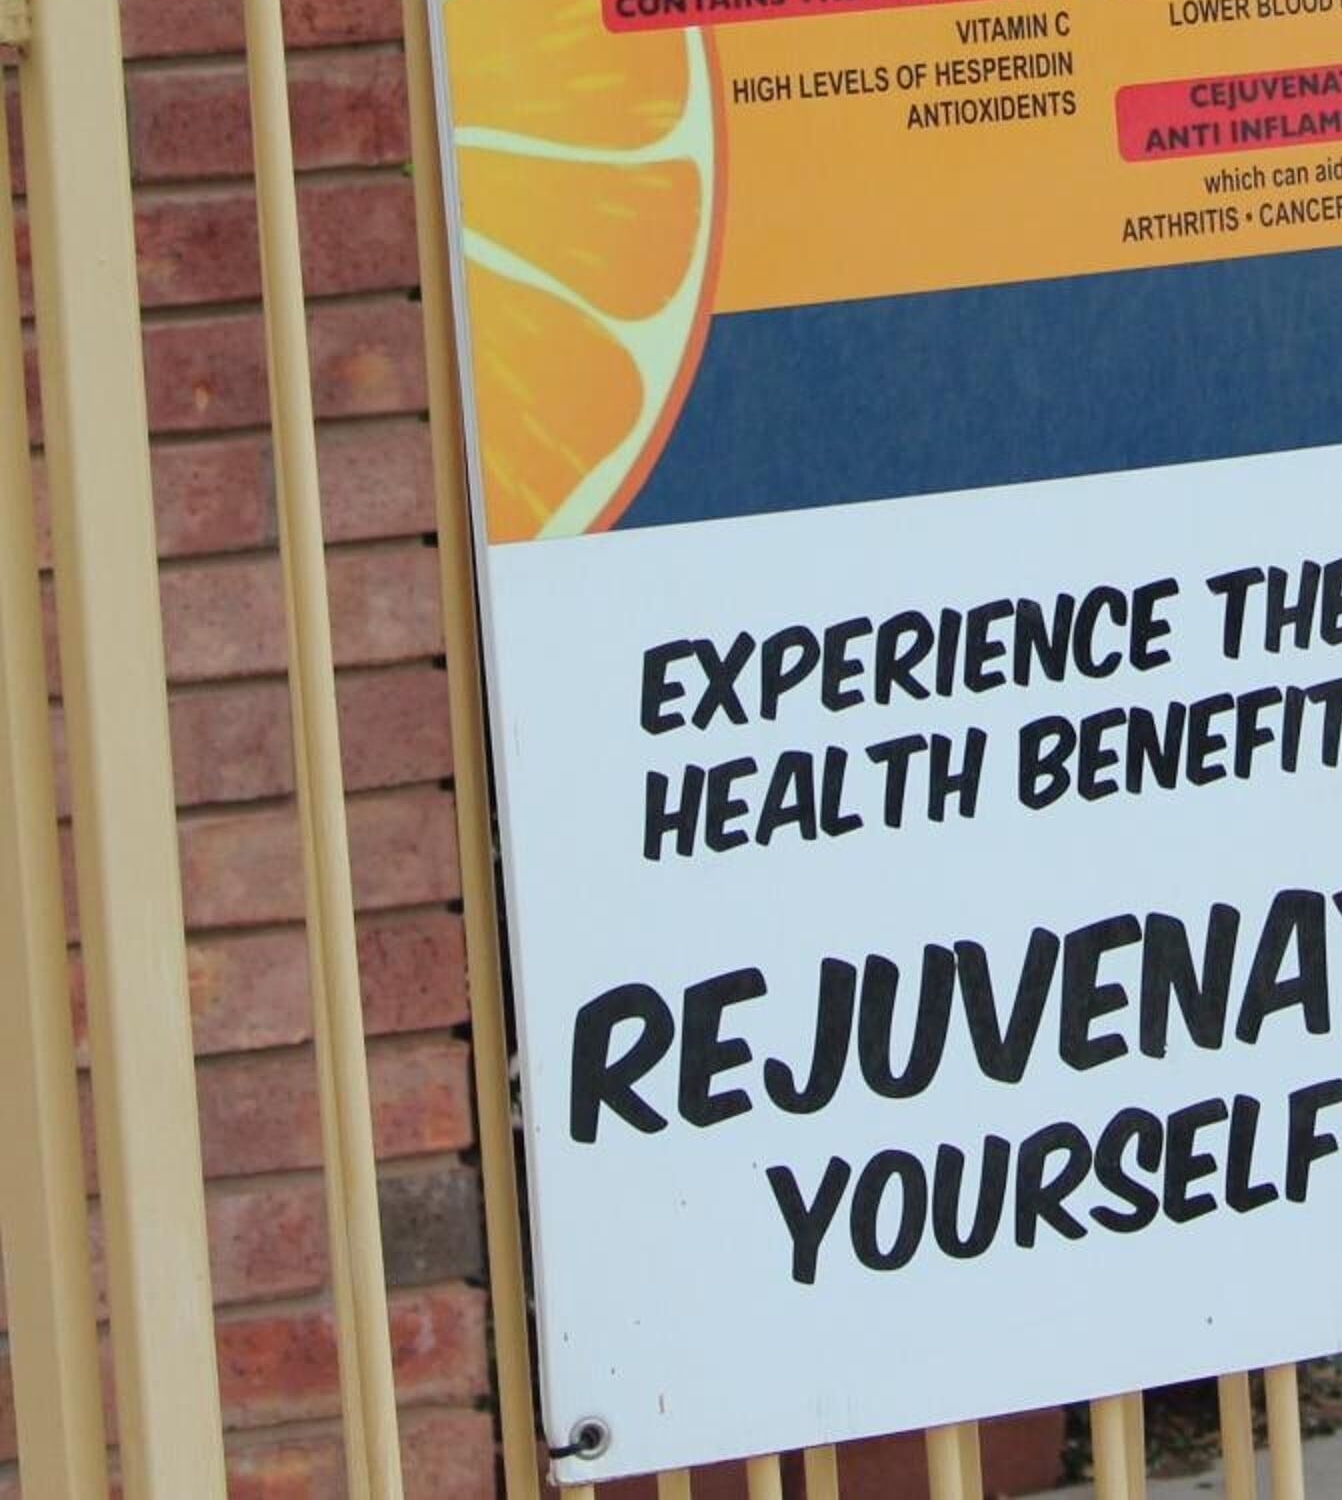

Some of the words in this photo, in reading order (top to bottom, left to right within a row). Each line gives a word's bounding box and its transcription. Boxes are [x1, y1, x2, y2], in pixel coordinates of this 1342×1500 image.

[956, 14, 1048, 44] VITAMIN
[1055, 11, 1071, 37] C
[732, 75, 791, 104] HIGH
[800, 67, 890, 98] LEVELS
[896, 64, 927, 90] OF
[935, 51, 1074, 86] HESPERIDIN
[907, 90, 1077, 130] ANTIOXIDENTS
[1145, 122, 1221, 153] ANTI
[1204, 165, 1266, 195] which
[1272, 163, 1309, 187] can
[1122, 206, 1240, 243] ARTHRITIS
[639, 577, 1180, 736] EXPERIENCE
[643, 726, 988, 861] HEALTH
